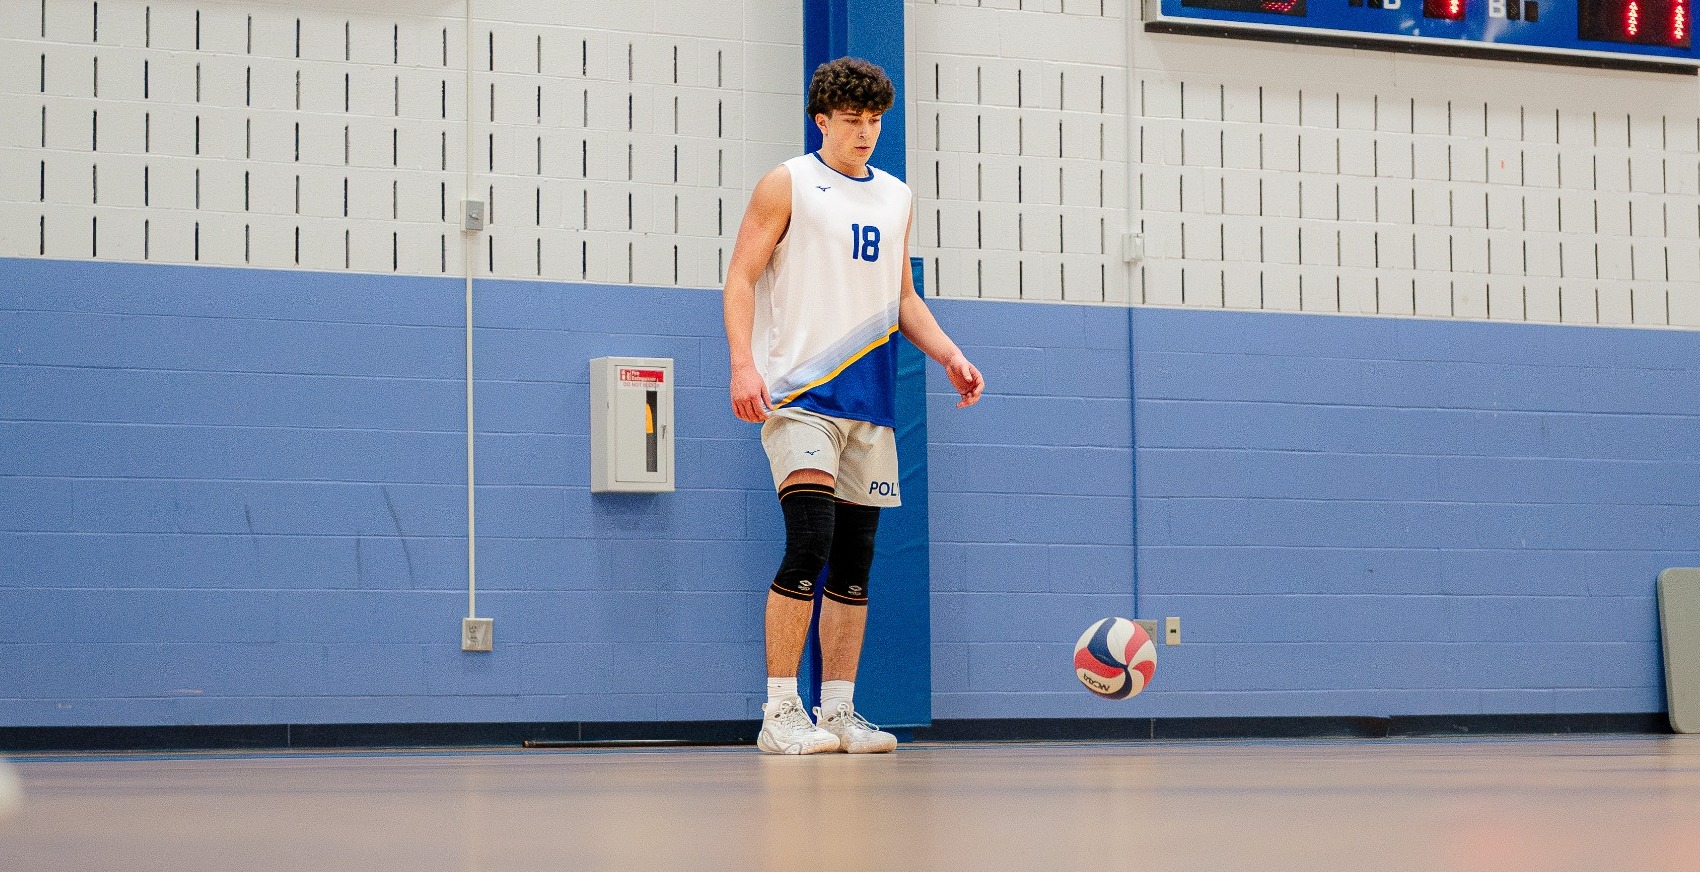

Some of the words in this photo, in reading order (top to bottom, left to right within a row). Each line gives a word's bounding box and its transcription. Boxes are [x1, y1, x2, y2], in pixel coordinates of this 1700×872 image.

[852, 223, 881, 262] 18
[868, 481, 899, 497] POL
[1083, 673, 1110, 692] NCAA
